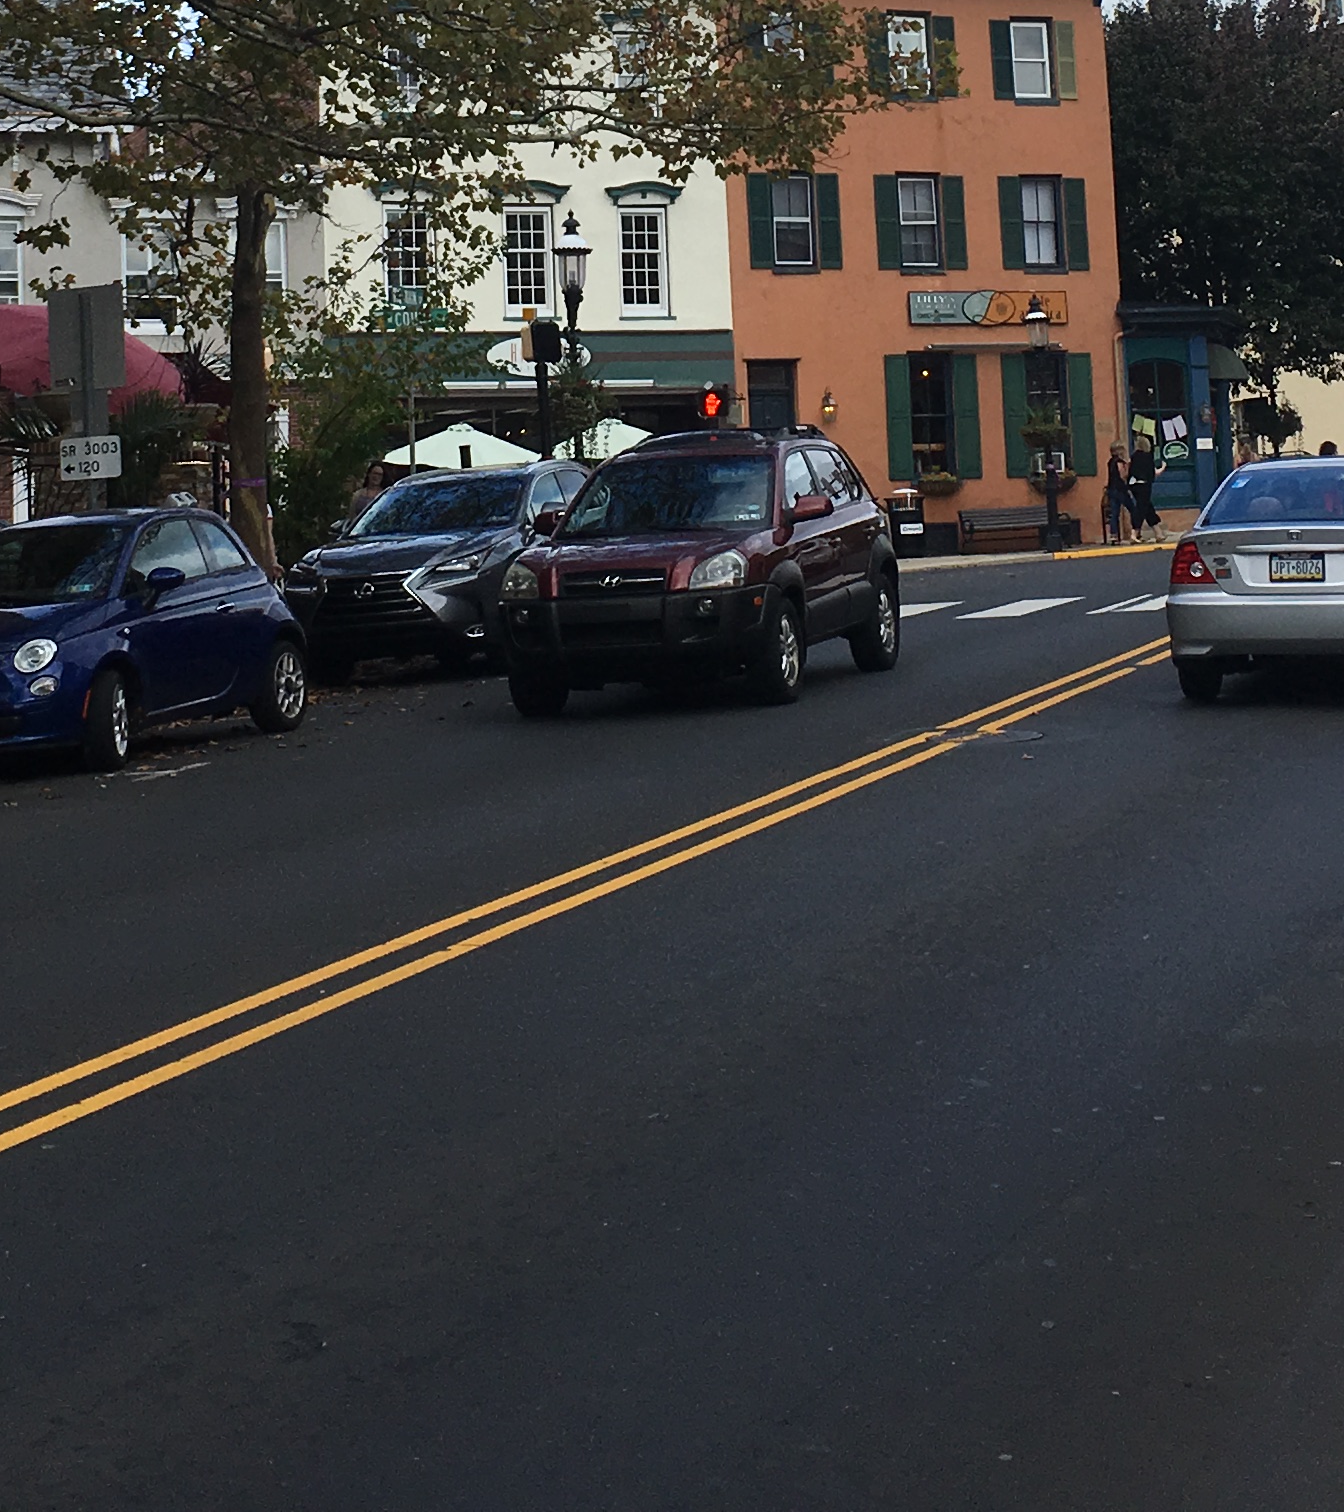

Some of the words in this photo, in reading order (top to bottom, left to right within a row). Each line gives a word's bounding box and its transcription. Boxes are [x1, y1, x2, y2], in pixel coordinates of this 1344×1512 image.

[61, 445, 76, 458] SR
[84, 441, 118, 456] 3003
[78, 460, 100, 474] 120
